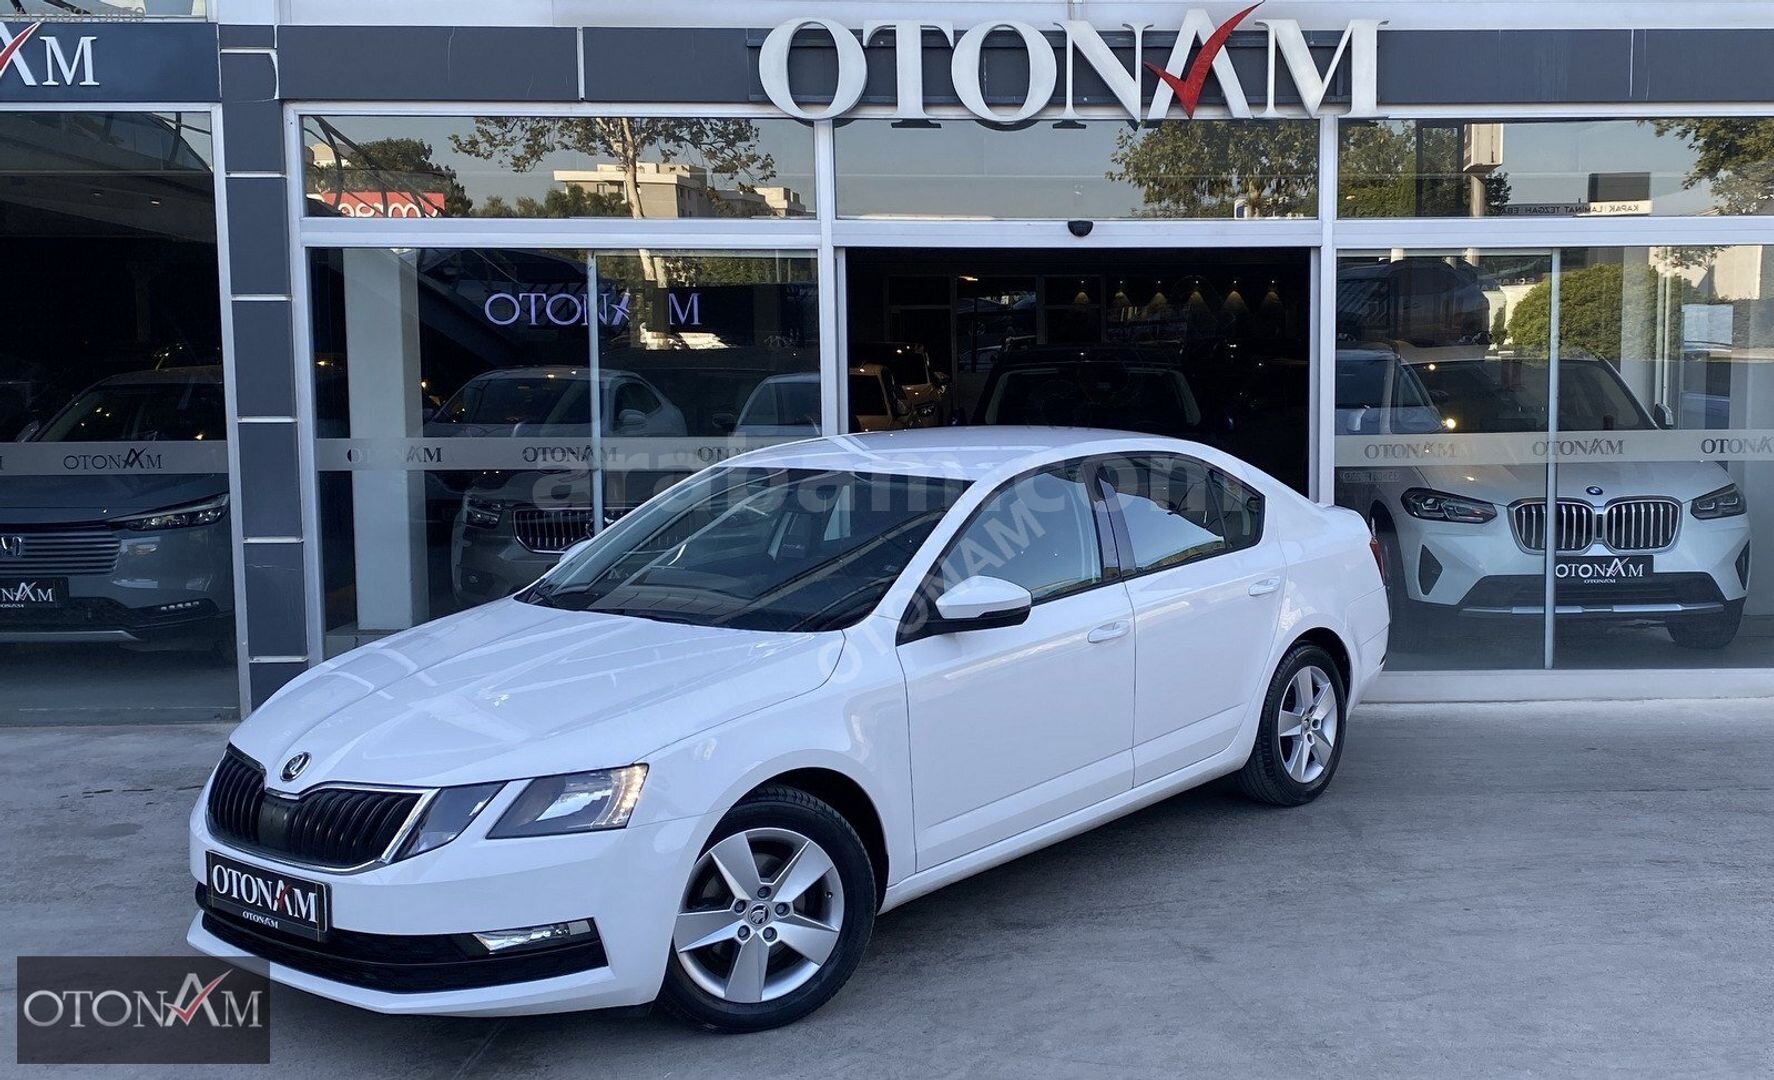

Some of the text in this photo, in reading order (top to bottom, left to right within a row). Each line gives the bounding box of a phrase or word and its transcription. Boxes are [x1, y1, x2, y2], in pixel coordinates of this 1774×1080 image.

[758, 2, 1389, 123] OTONAM
[1531, 437, 1626, 457] OTONAM
[63, 447, 163, 470] OTONAM
[1554, 556, 1645, 578] OTONAM
[212, 864, 318, 923] OTONAM
[242, 910, 279, 929] OTONAM
